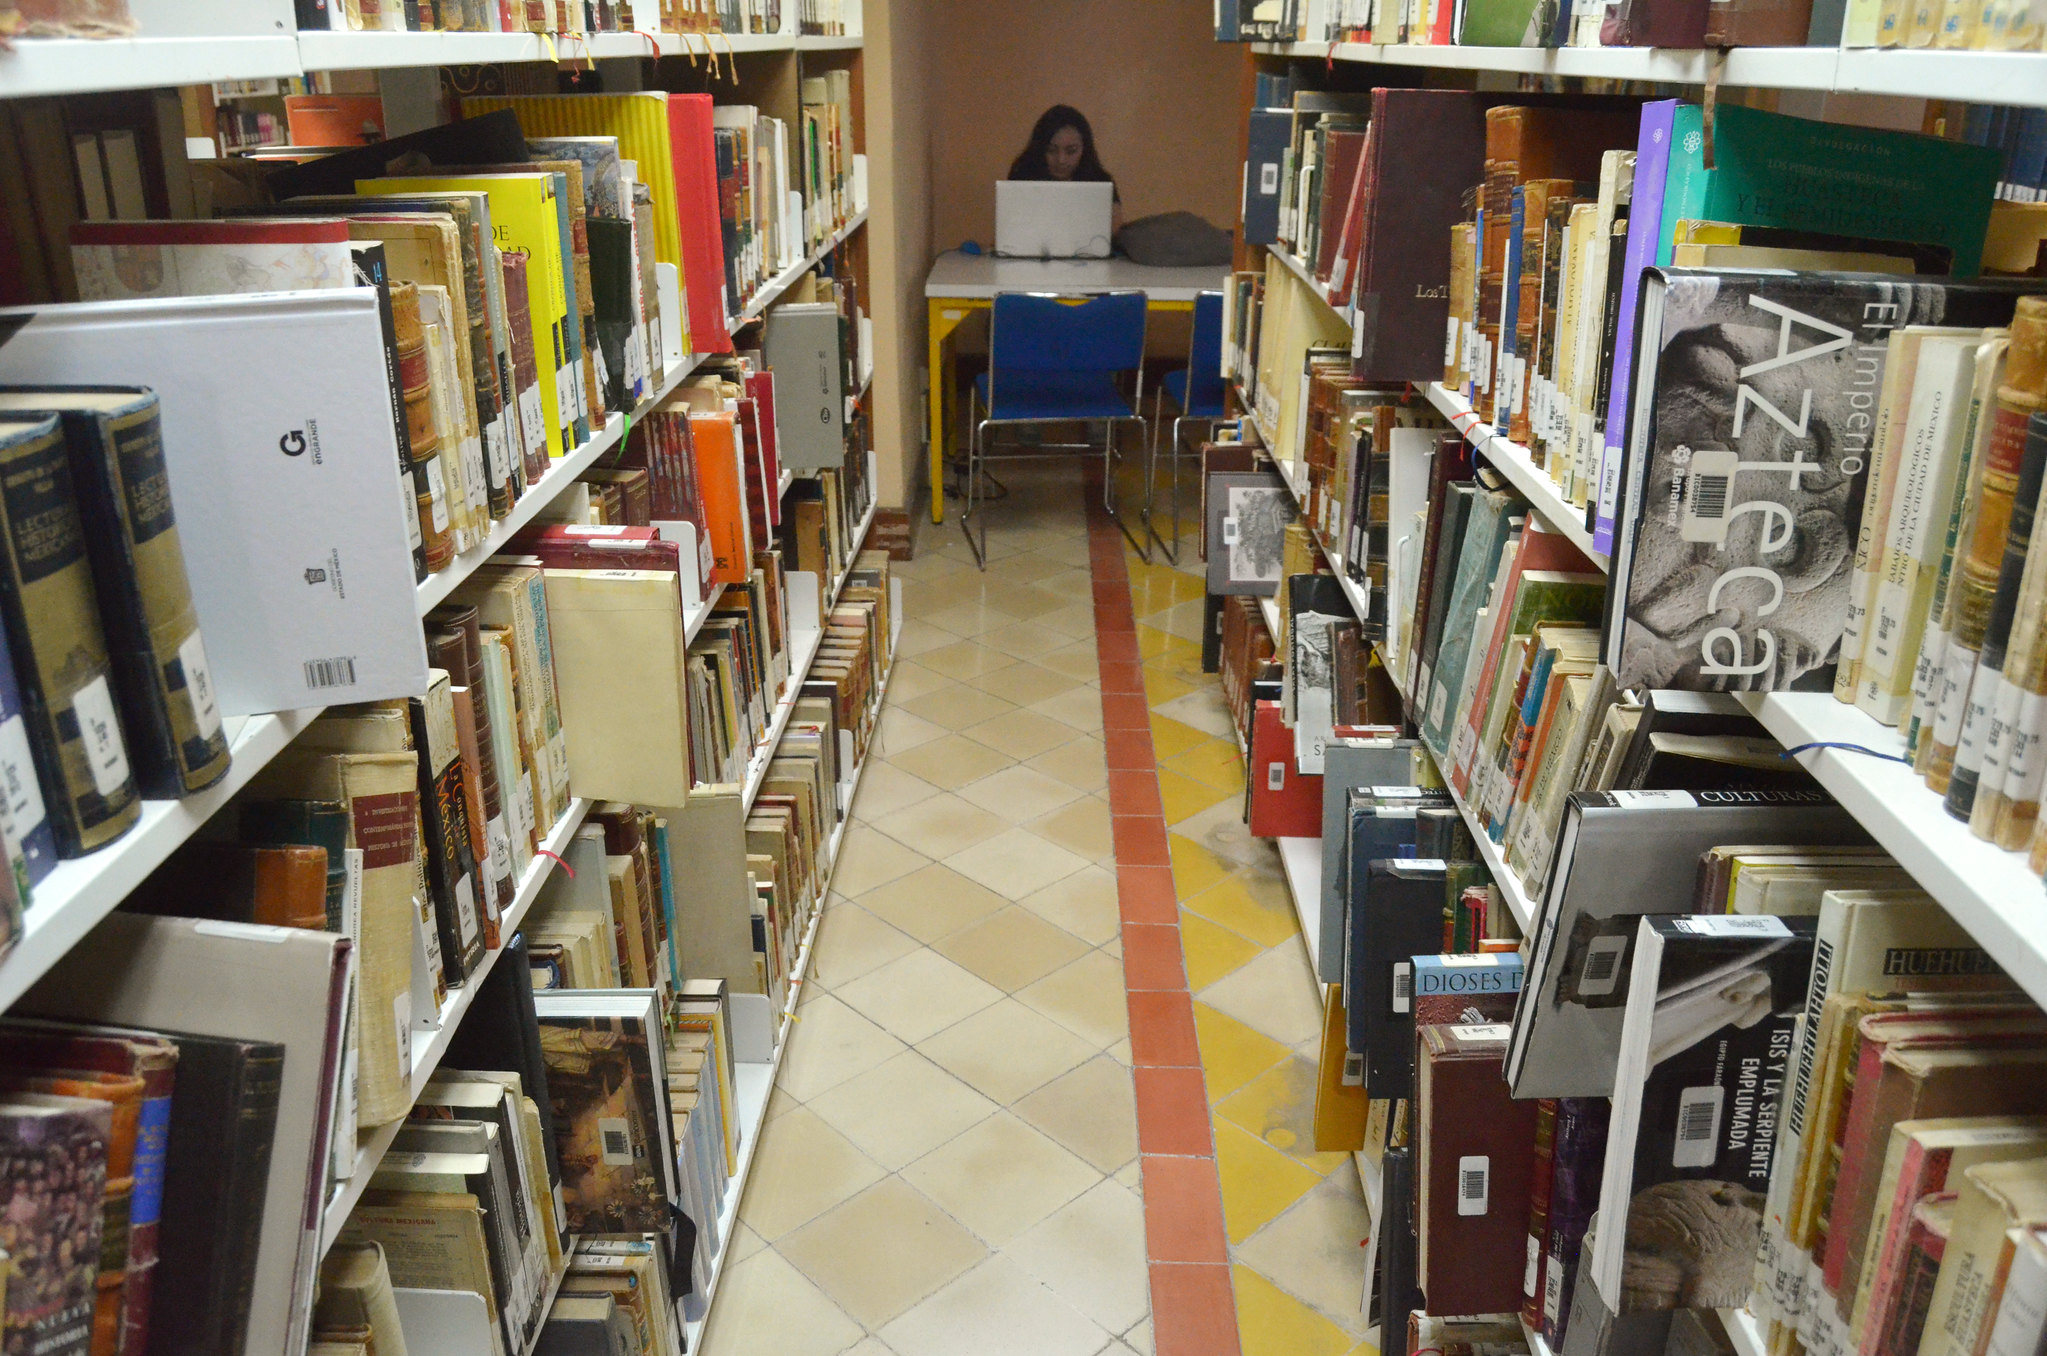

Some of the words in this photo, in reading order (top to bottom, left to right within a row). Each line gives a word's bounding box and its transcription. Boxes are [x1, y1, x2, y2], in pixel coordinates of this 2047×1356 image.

[1735, 193, 1747, 212] Y
[1754, 197, 1774, 217] EL
[1415, 284, 1439, 298] Los
[1863, 303, 1897, 329] El
[1840, 346, 1888, 476] Imperio
[1921, 443, 1933, 461] DE
[1666, 466, 1684, 528] Banamex
[1700, 294, 1854, 675] Azteca
[1910, 463, 1931, 510] CIUDAD
[1907, 515, 1918, 531] LA
[1903, 531, 1916, 550] DE
[1888, 536, 1905, 583] RABAJOS
[1895, 551, 1913, 587] NTRO
[449, 761, 462, 781] La
[1700, 790, 1822, 802] CULTURAS
[435, 775, 455, 860] México
[452, 782, 468, 847] Conquista
[1423, 970, 1501, 993] DIOSES
[1717, 1039, 1727, 1061] EGIPTO
[1767, 1027, 1791, 1060] ISIS
[1713, 1061, 1724, 1086] FARAÓN
[1765, 1060, 1785, 1073] Y
[1760, 1076, 1781, 1098] LA
[1727, 1055, 1760, 1152] EMPLUMADA
[1747, 1100, 1777, 1180] SERPIENTE
